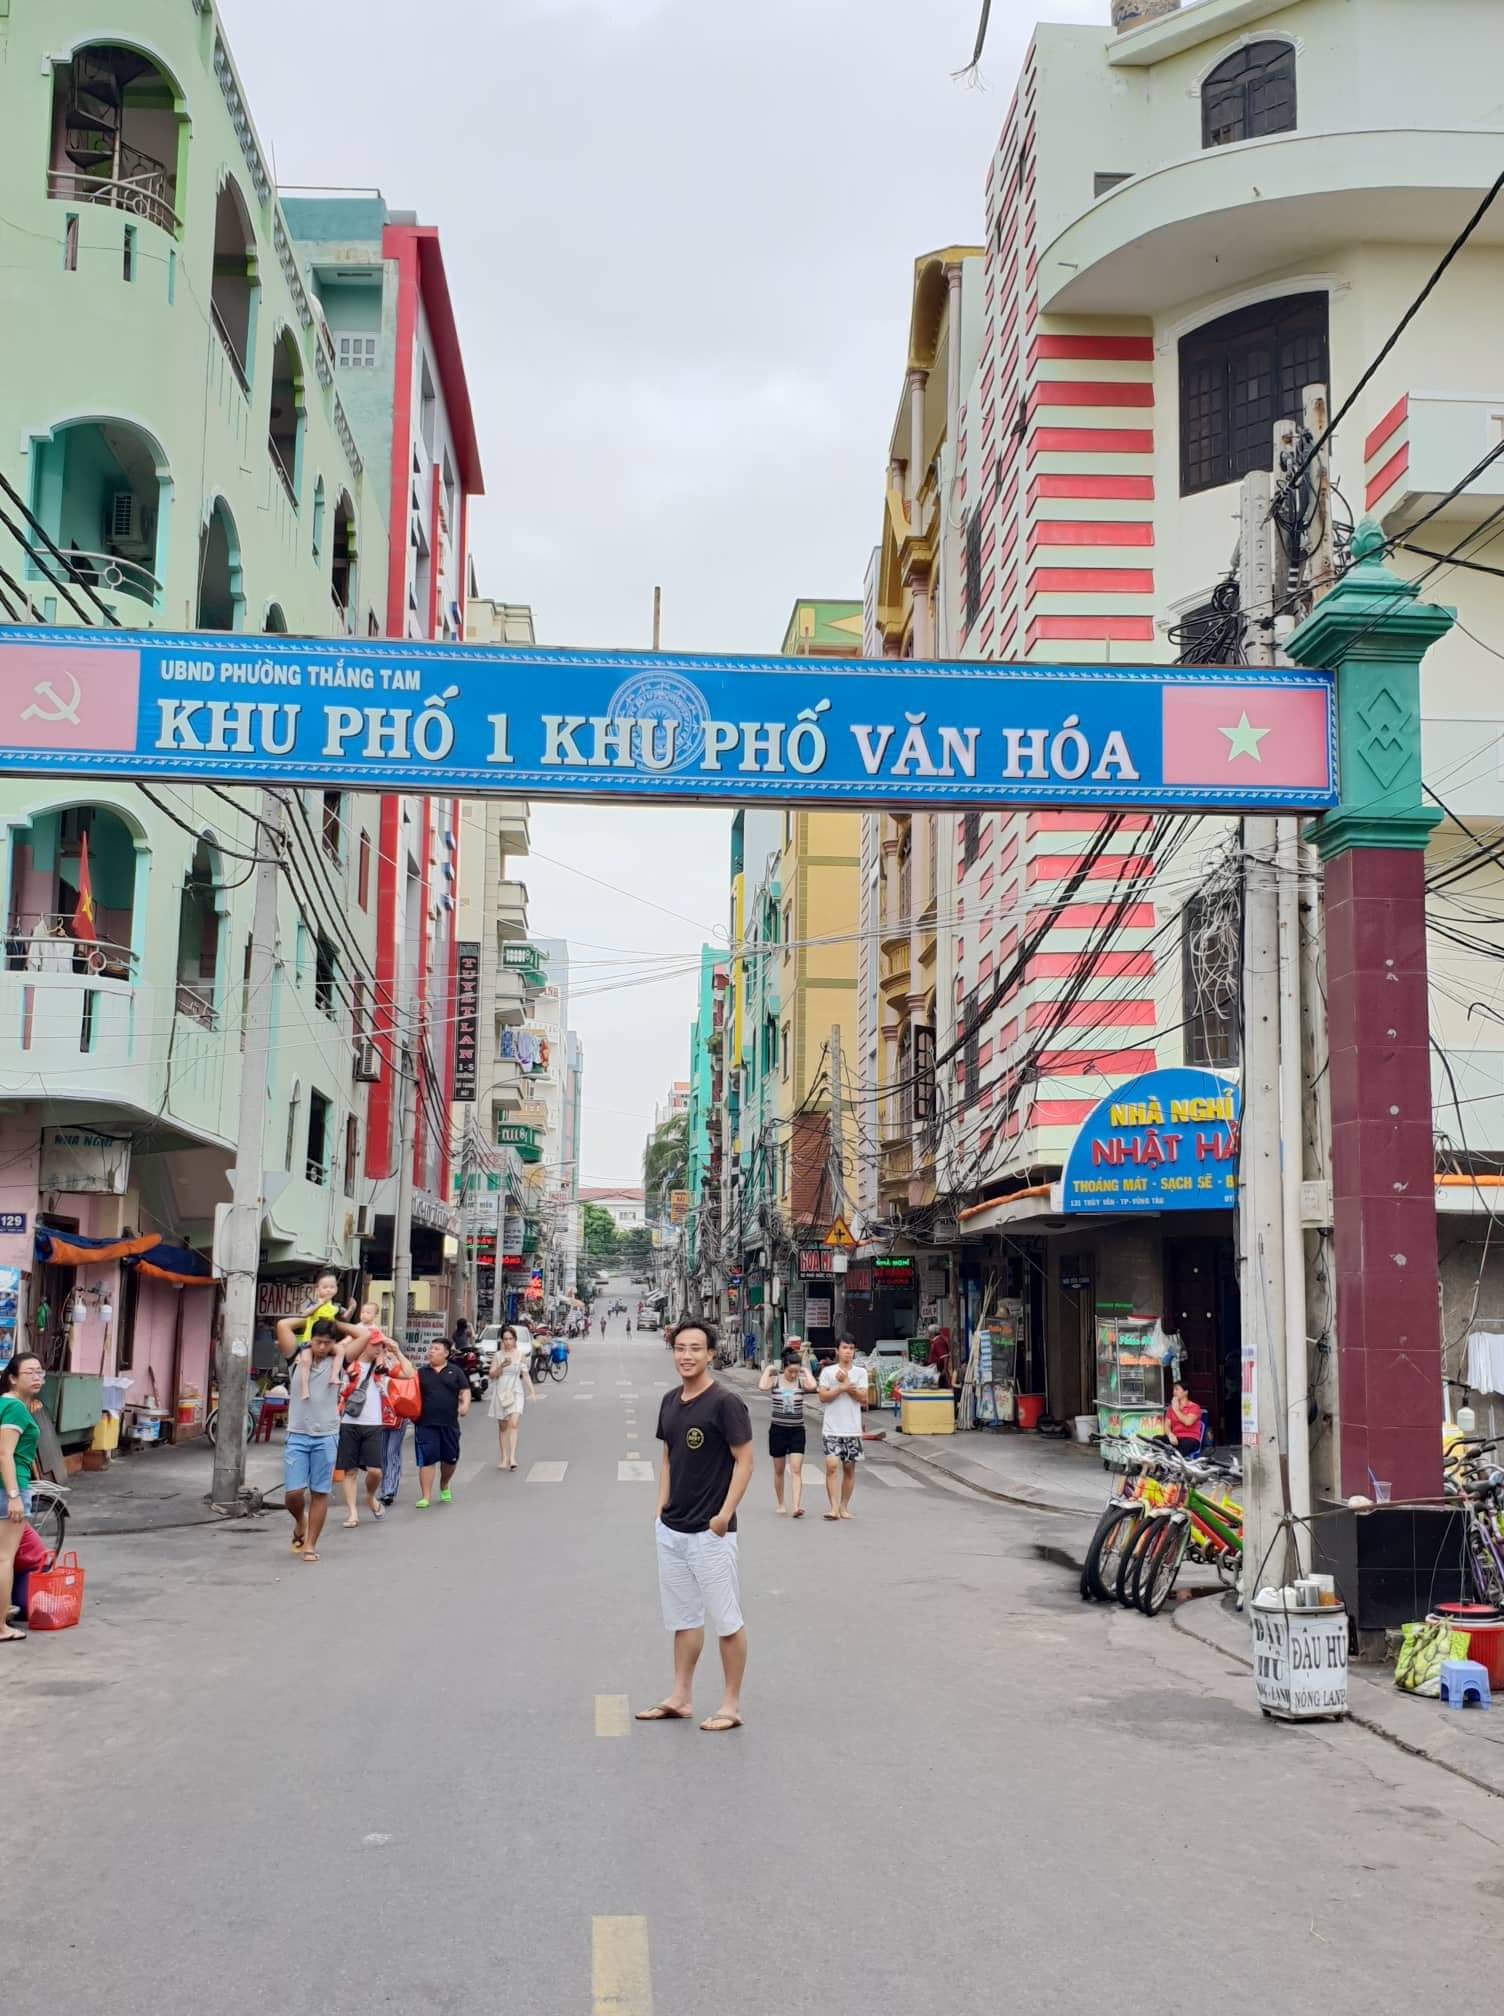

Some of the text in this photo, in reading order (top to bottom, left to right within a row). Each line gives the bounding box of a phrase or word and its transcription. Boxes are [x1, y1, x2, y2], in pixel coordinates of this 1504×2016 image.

[161, 659, 421, 691] UBND PHƯỜNG THẮNG TAM
[155, 699, 302, 755] KHU
[322, 684, 460, 761] PHỐ
[486, 713, 514, 764] 1
[540, 714, 679, 769] KHU
[700, 697, 832, 774] PHỐ
[850, 711, 982, 777] VĂN
[1001, 714, 1140, 780] HÓA
[1110, 1088, 1235, 1127] NHÀ NGHỈ
[1092, 1128, 1183, 1169] NHẬT
[1072, 1177, 1120, 1193] THOÁNG
[1123, 1175, 1149, 1192] MÁT
[1160, 1175, 1193, 1193] SẠCH
[1, 1215, 23, 1227] 129
